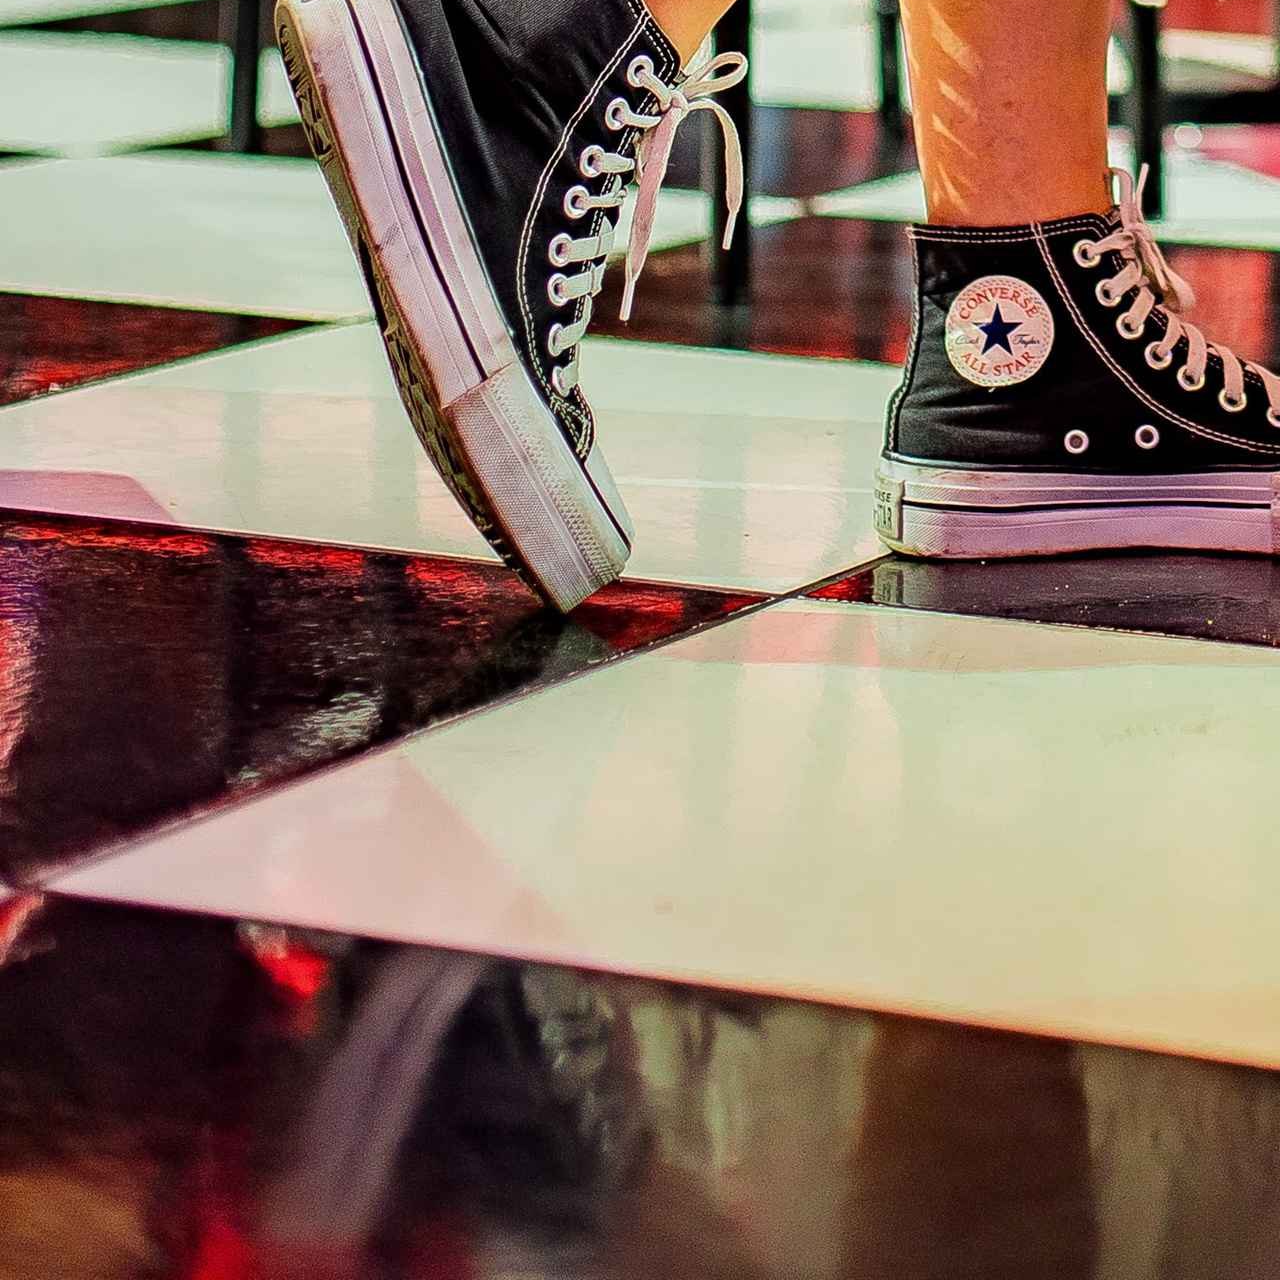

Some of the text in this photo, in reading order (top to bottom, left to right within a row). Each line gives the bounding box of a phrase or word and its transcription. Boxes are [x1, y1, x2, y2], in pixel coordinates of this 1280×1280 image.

[958, 286, 1040, 320] CONVERSE
[959, 351, 1036, 377] ALL STAR
